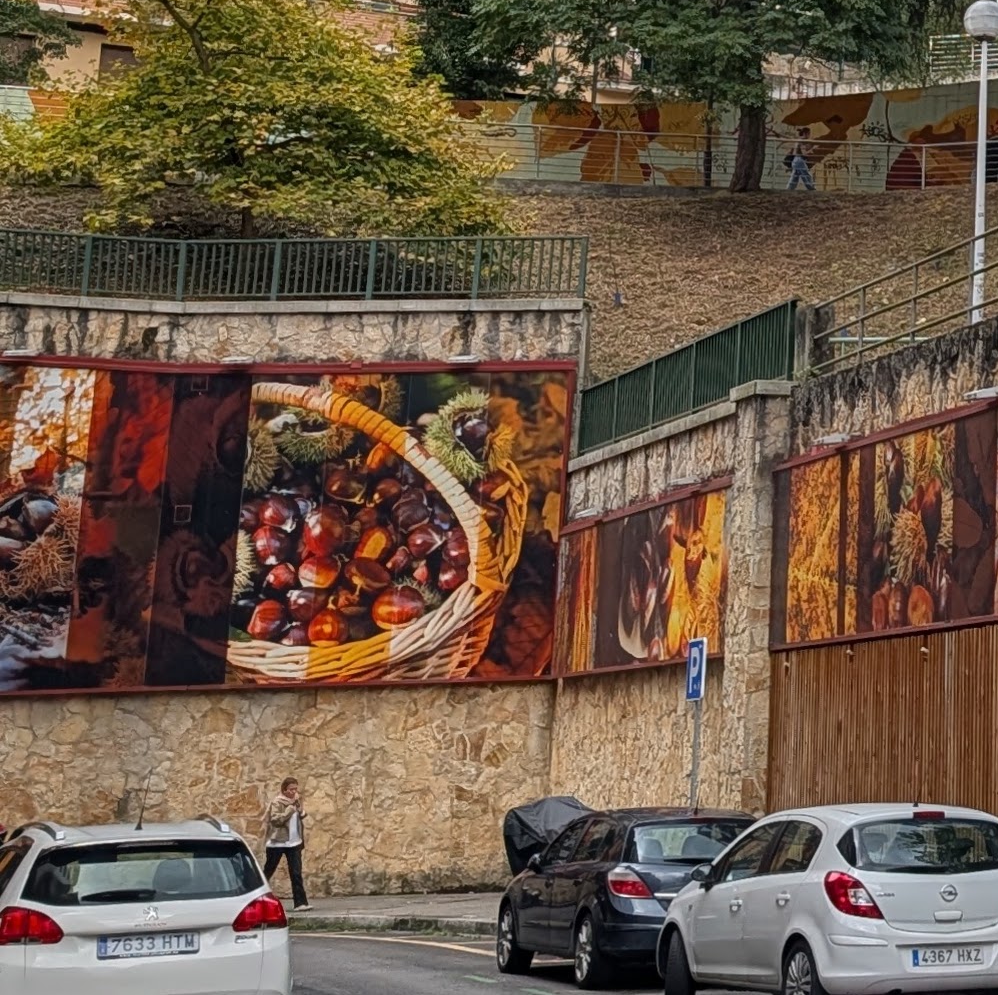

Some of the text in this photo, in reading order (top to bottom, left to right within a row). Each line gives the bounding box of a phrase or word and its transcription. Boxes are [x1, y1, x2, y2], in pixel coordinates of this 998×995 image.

[689, 647, 700, 693] P
[111, 934, 195, 952] 7633 HTM
[921, 949, 981, 963] 4367 HXZ
